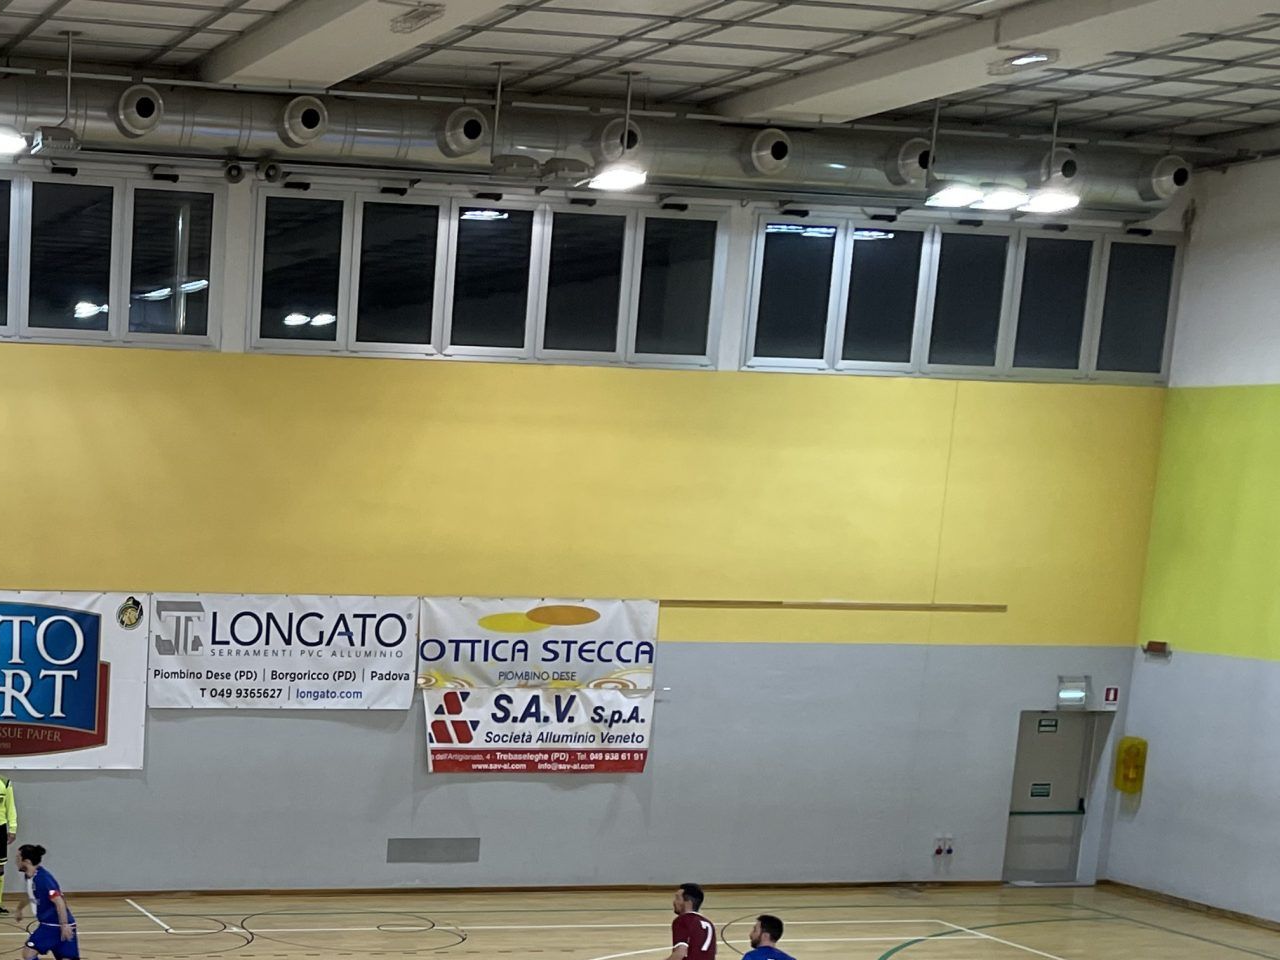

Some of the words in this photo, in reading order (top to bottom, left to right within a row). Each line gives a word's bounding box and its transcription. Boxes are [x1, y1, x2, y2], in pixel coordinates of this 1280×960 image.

[211, 611, 408, 648] LONGATO
[210, 648, 293, 657] SERRAMENTI
[300, 649, 323, 658] PVC
[331, 649, 404, 658] ALLUMINIO
[419, 638, 529, 663] OTTICA
[540, 639, 654, 664] STECCA
[153, 669, 203, 680] Piombino
[206, 670, 232, 680] Dese
[234, 669, 258, 682] (PD)
[270, 669, 330, 683] Borgoricco
[332, 670, 357, 682] (PD)
[370, 670, 410, 681] Padova
[498, 671, 550, 681] PIOMBINO
[551, 671, 577, 681] DESE
[199, 688, 207, 698] T
[209, 688, 233, 698] 049
[235, 688, 283, 699] 9365627
[295, 688, 363, 701] longato.com
[490, 693, 577, 724] S.A.V.
[589, 705, 646, 728] S.p.A.
[26, 729, 62, 742] PAPER
[484, 731, 533, 744] Società
[535, 731, 596, 744] Alluminio
[599, 732, 645, 745] Veneto
[495, 752, 549, 763] Trebaseleghe
[550, 752, 569, 762] (PD)
[604, 752, 620, 761] 938
[620, 752, 631, 761] 61
[633, 752, 644, 761] 91
[699, 920, 714, 951] 7
